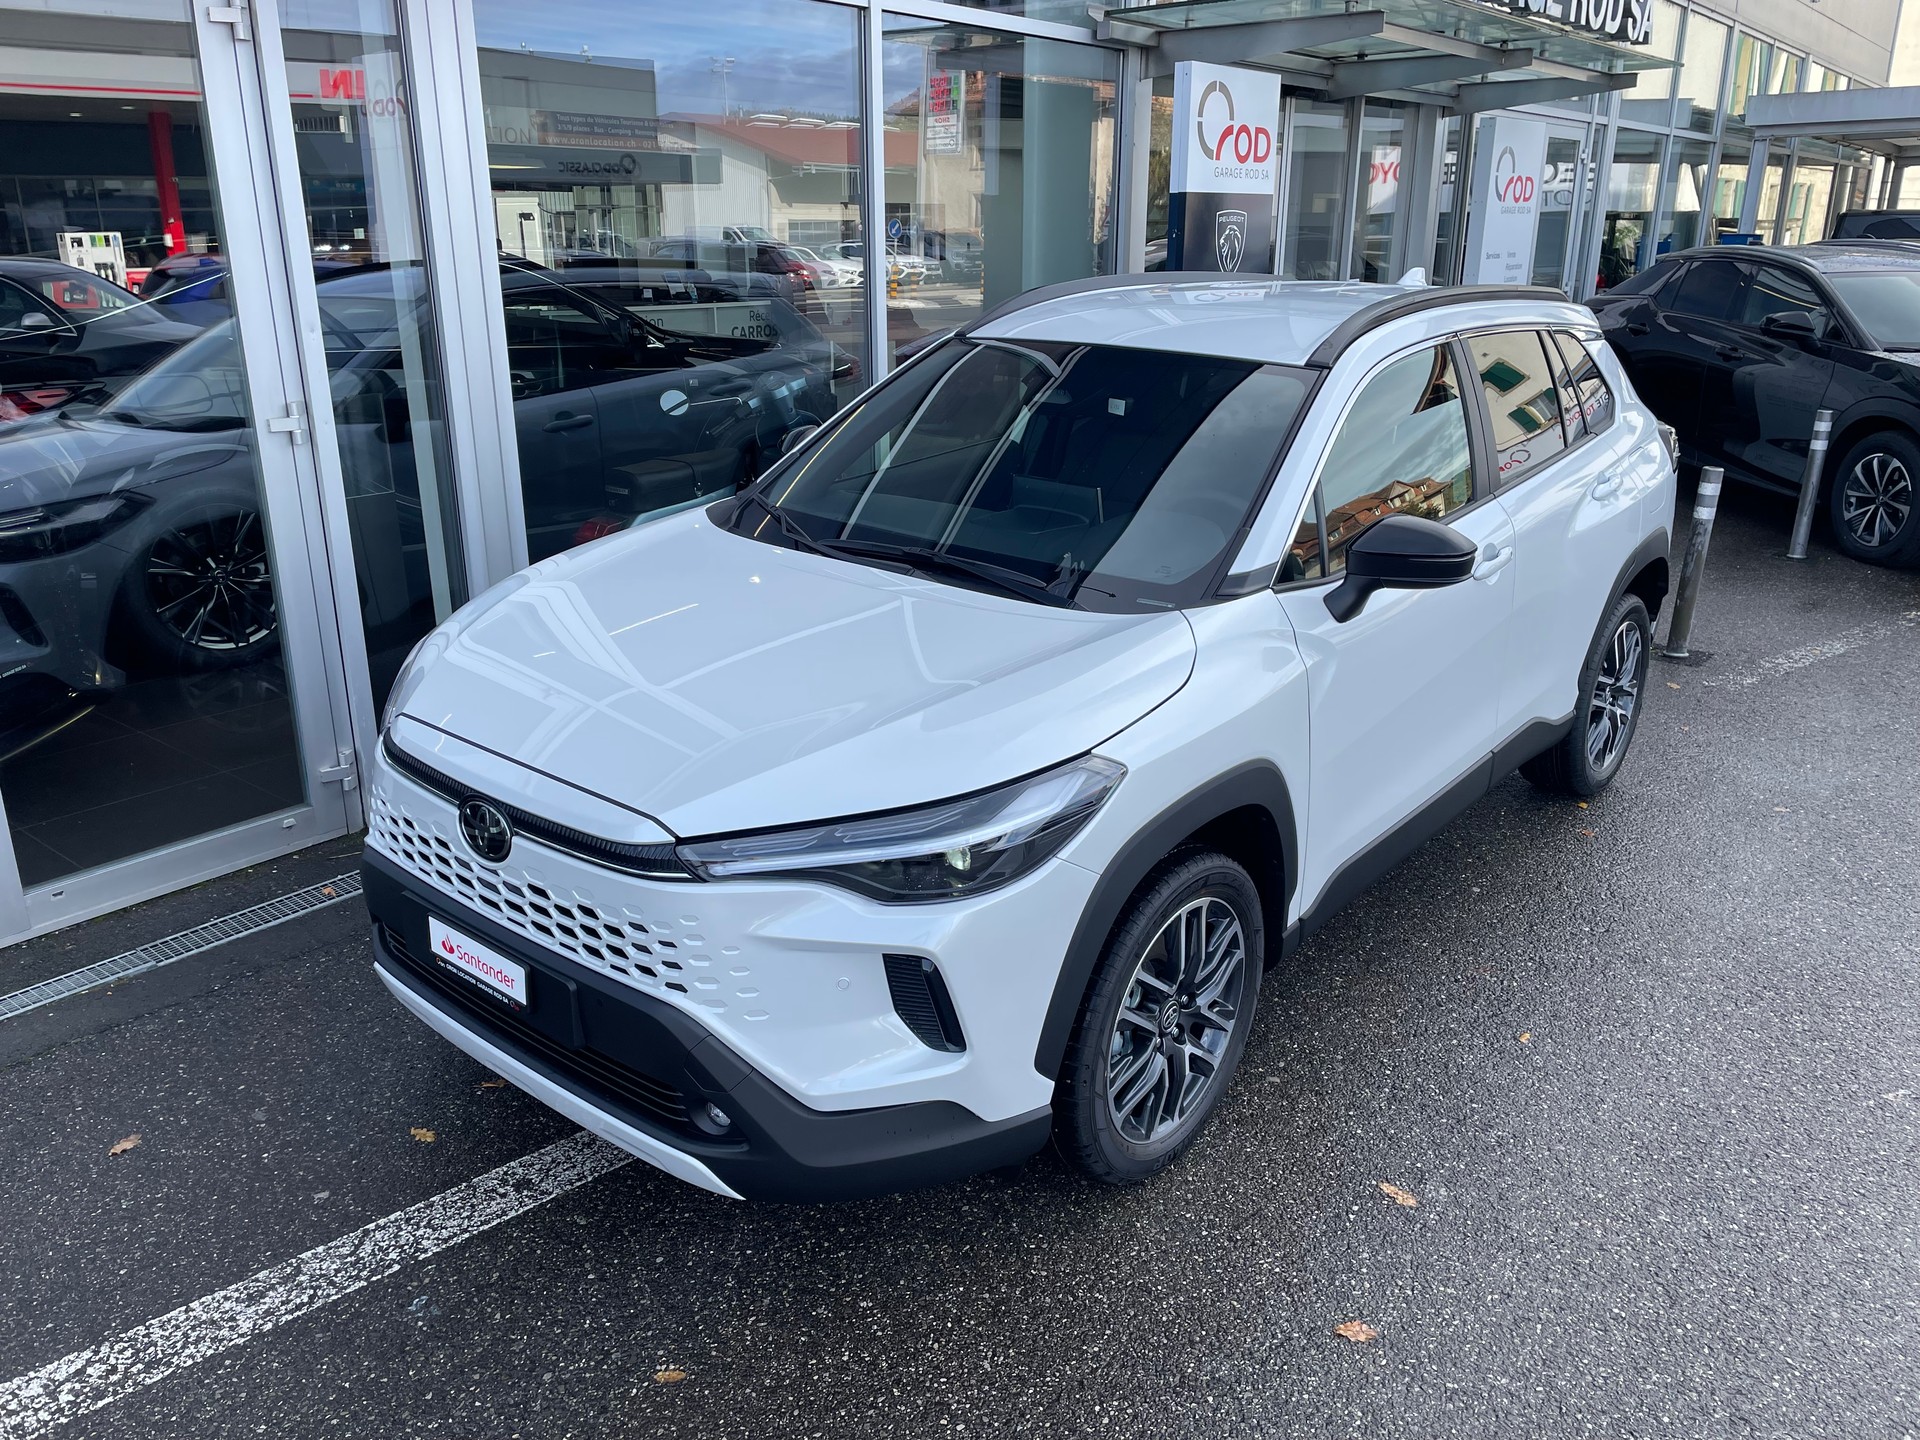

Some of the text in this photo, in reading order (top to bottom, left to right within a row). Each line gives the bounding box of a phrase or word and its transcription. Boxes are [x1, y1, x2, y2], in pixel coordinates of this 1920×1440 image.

[1628, 0, 1653, 42] SA
[571, 115, 586, 124] types
[573, 125, 590, 133] places
[607, 127, 631, 136] Camping
[1213, 166, 1270, 180] GARAGE ROD SA
[1500, 206, 1531, 215] GARAGE ROD SA
[1218, 215, 1245, 223] PEUGEOT
[456, 944, 515, 990] Santander
[457, 969, 477, 985] LOCATION
[477, 981, 494, 996] GARAGE
